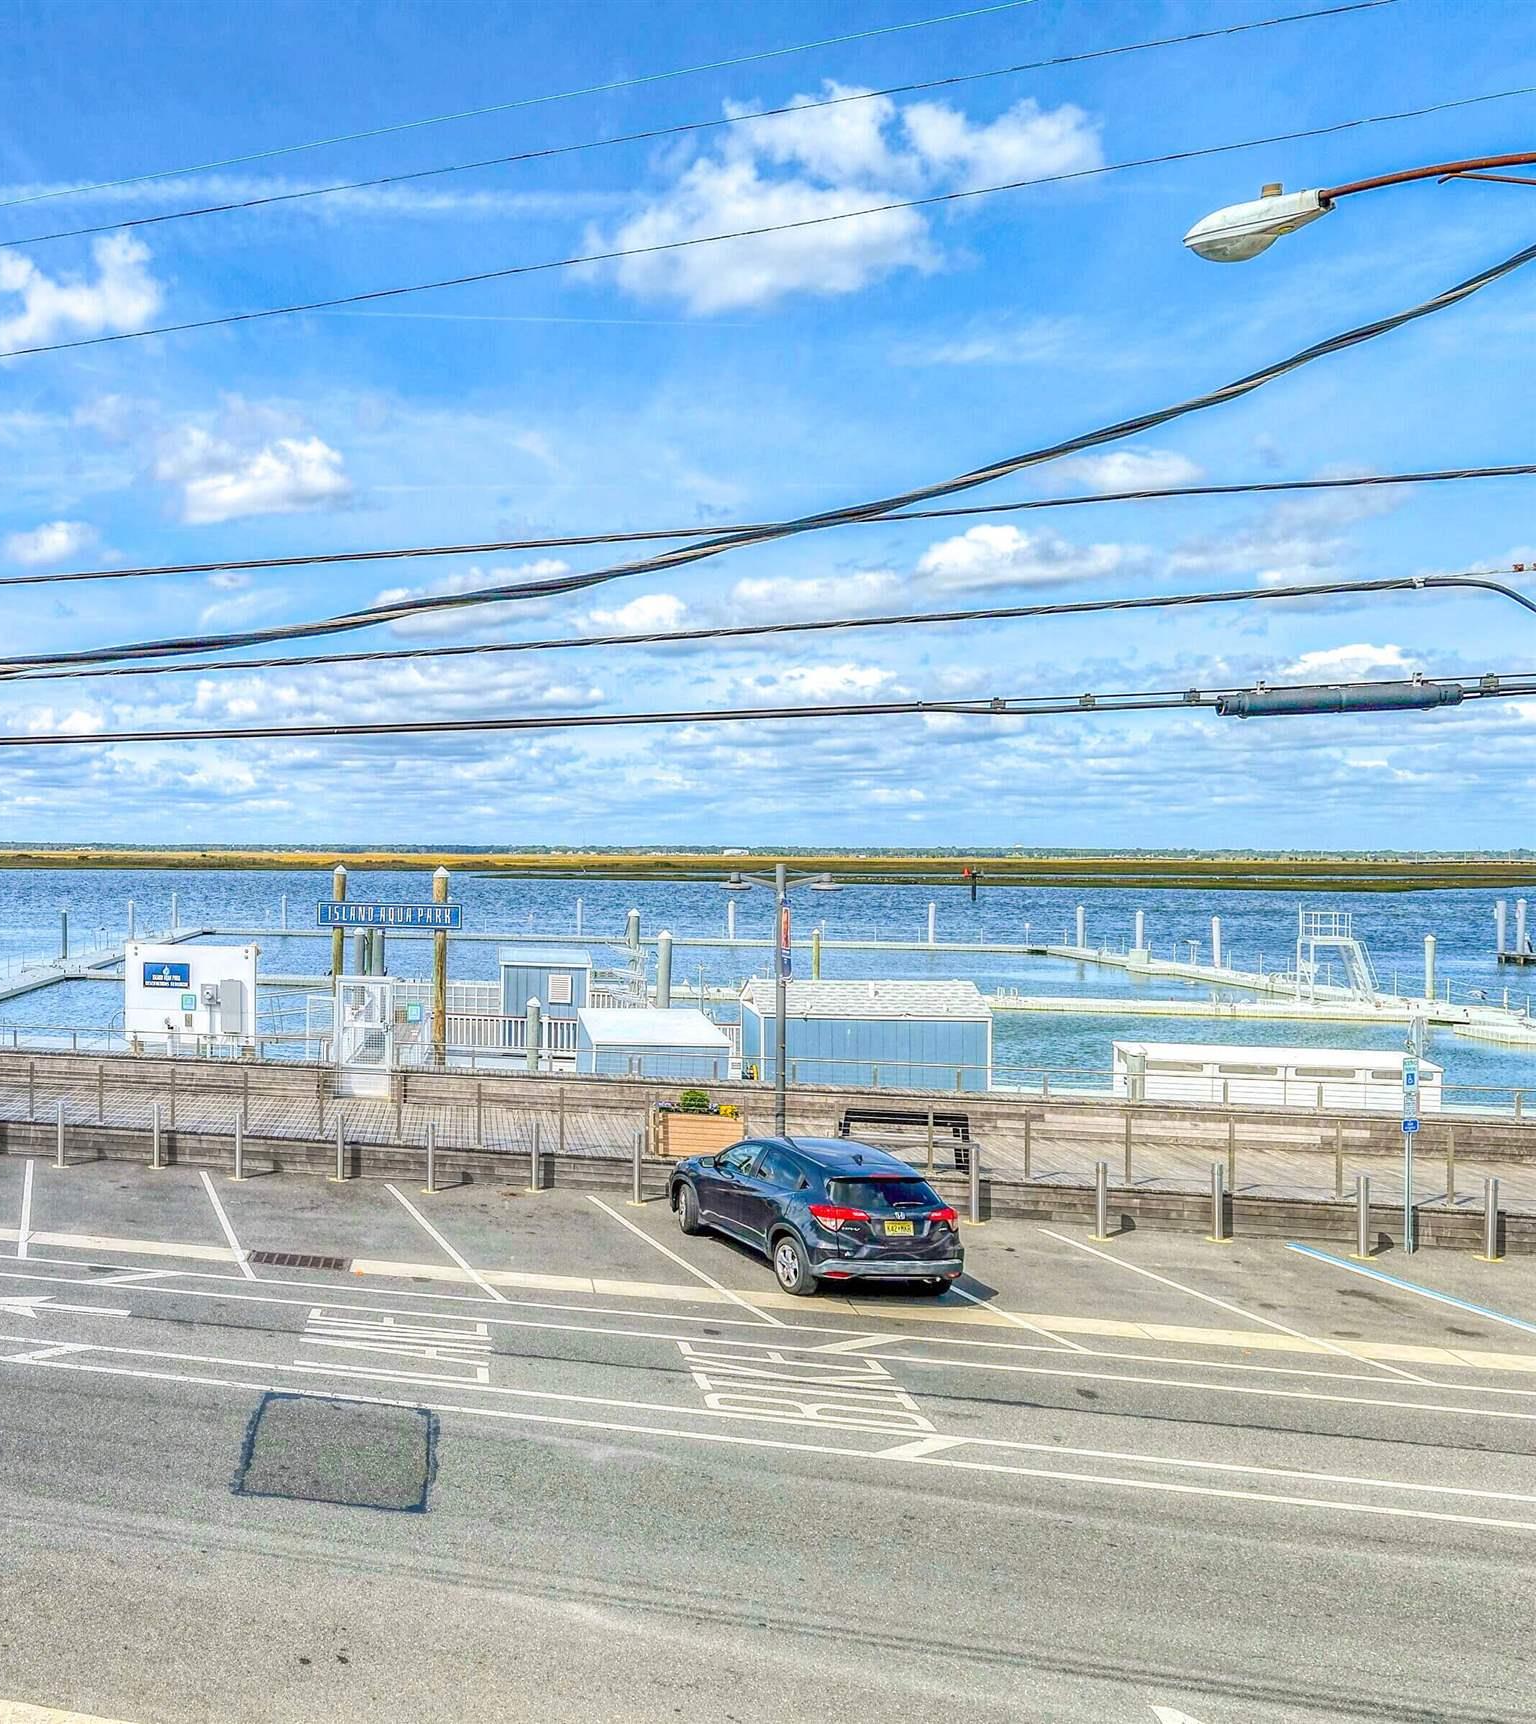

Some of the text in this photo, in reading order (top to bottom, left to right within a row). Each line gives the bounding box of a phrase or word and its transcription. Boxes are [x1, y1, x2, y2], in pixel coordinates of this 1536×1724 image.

[328, 905, 451, 925] ISLAND AQUA PARK
[293, 1308, 495, 1384] LANE
[676, 1341, 938, 1432] BIKE
